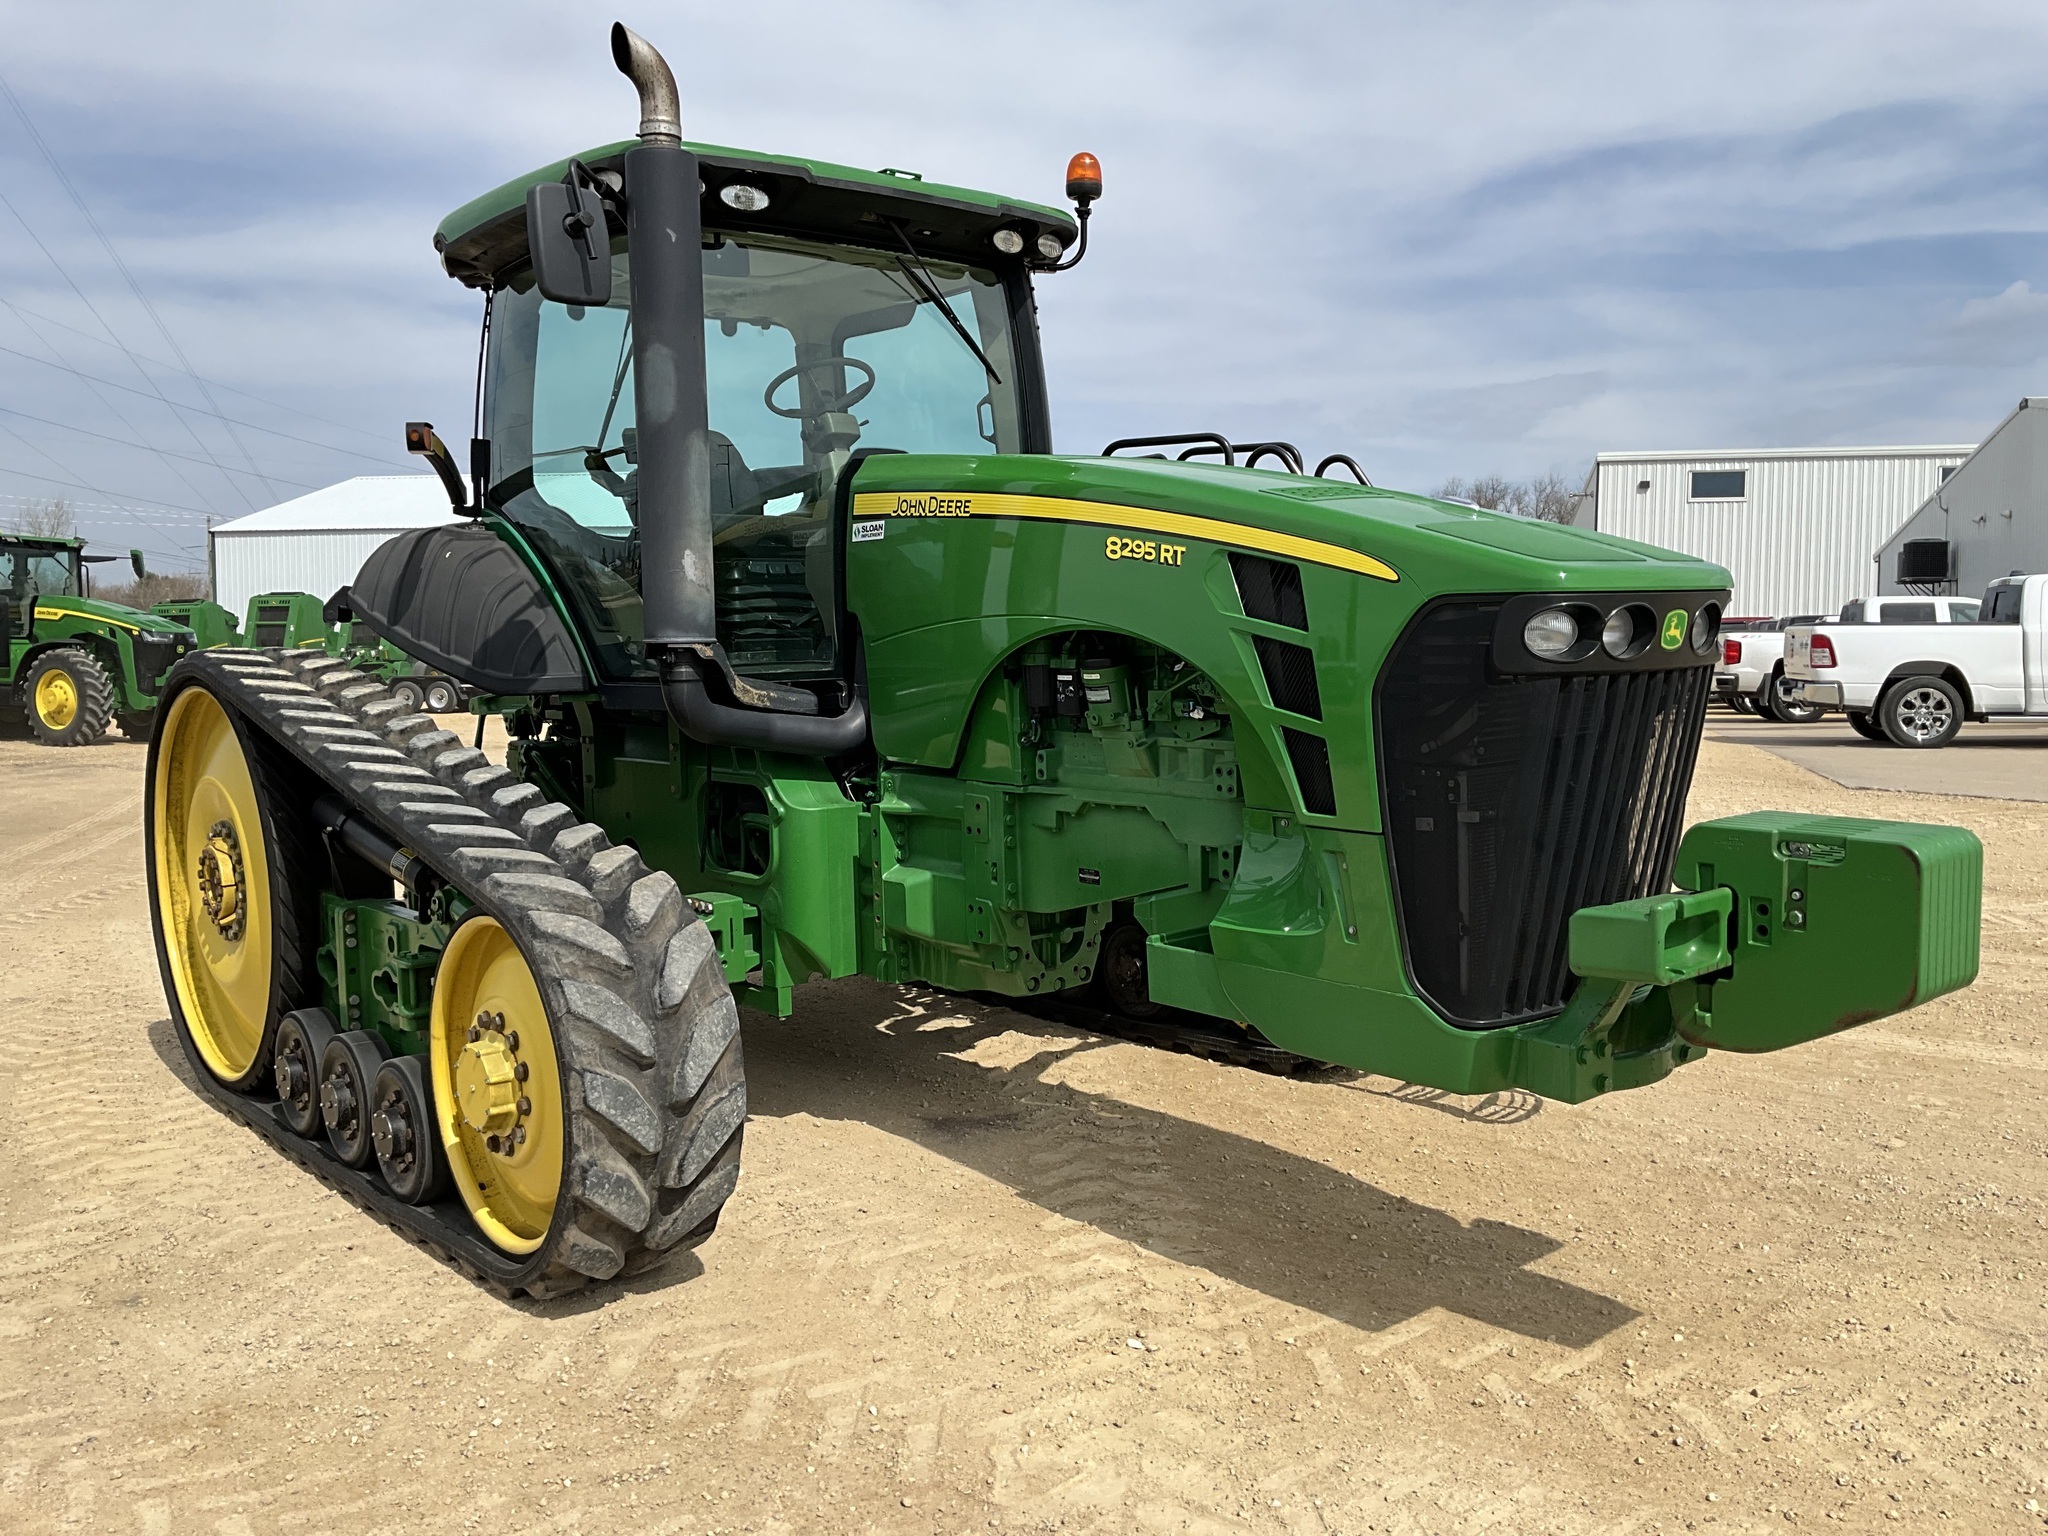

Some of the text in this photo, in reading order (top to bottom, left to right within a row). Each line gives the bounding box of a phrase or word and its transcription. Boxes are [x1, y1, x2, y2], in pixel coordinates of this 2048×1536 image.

[892, 495, 972, 516] JOHN DEERE
[861, 523, 883, 533] SLOAN
[1106, 536, 1186, 567] 8295 RT
